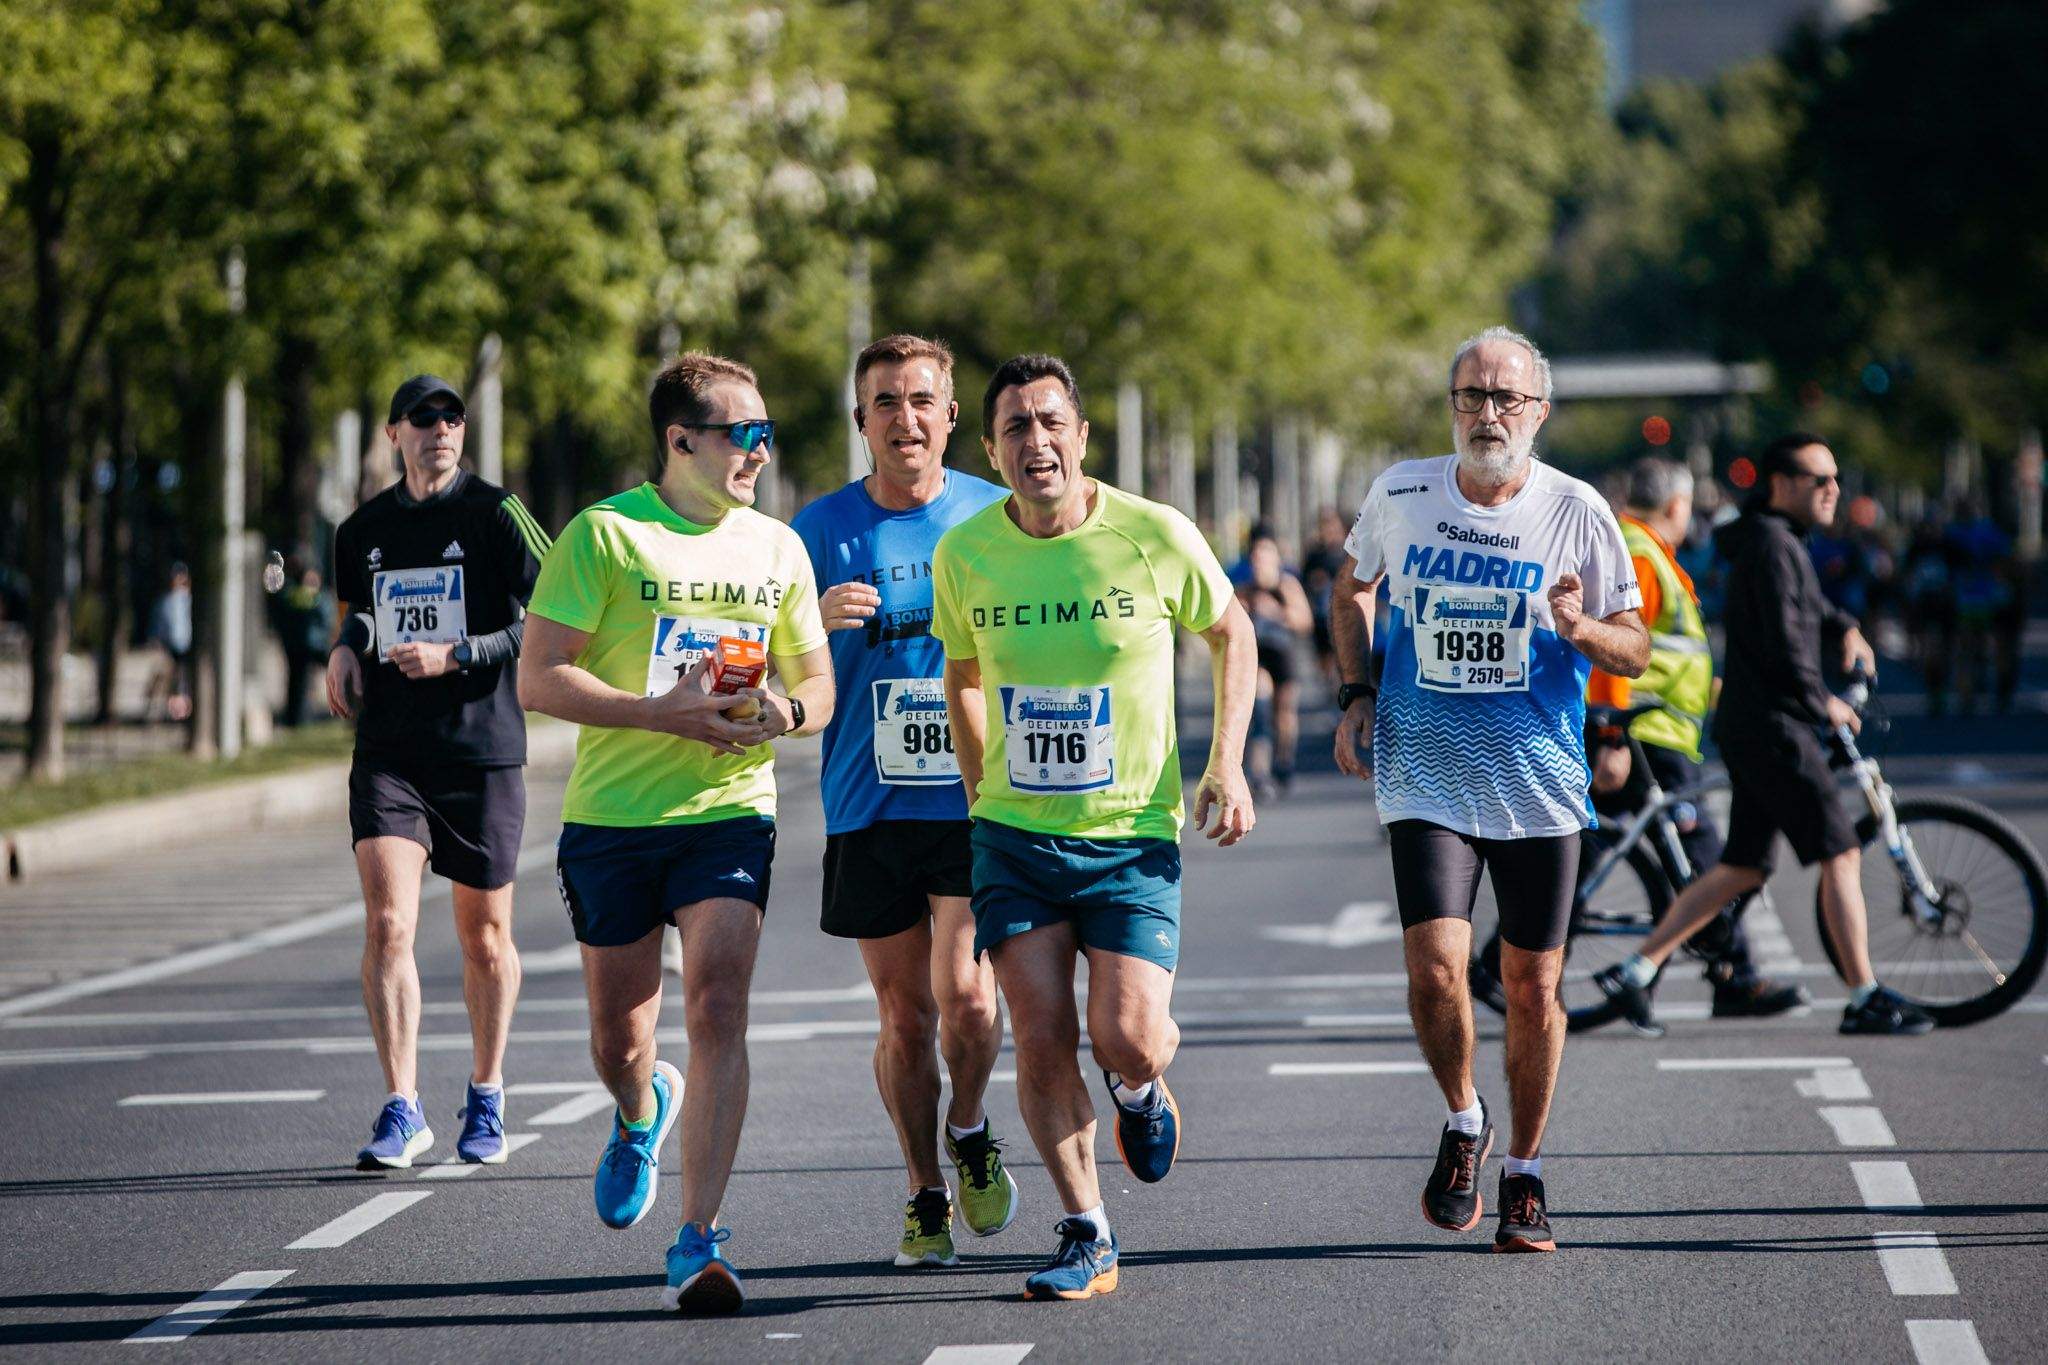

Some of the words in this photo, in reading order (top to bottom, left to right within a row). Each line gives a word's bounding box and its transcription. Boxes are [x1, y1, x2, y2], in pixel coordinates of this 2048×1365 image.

[1447, 525, 1520, 550] Sabadell
[1402, 544, 1544, 593] MADRID
[396, 594, 444, 604] DECIMAS
[641, 580, 782, 609] DECIMAS
[973, 597, 1134, 628] DECIMAS
[1448, 602, 1505, 612] BOMBEROS
[395, 605, 438, 632] 736
[1443, 620, 1504, 629] DECIMAS
[693, 632, 720, 644] BOM
[1433, 631, 1505, 662] 1938
[1468, 667, 1504, 684] 2579
[1033, 702, 1090, 712] BOMBEROS
[1028, 720, 1089, 730] DECIMAS
[1024, 732, 1087, 764] 1716
